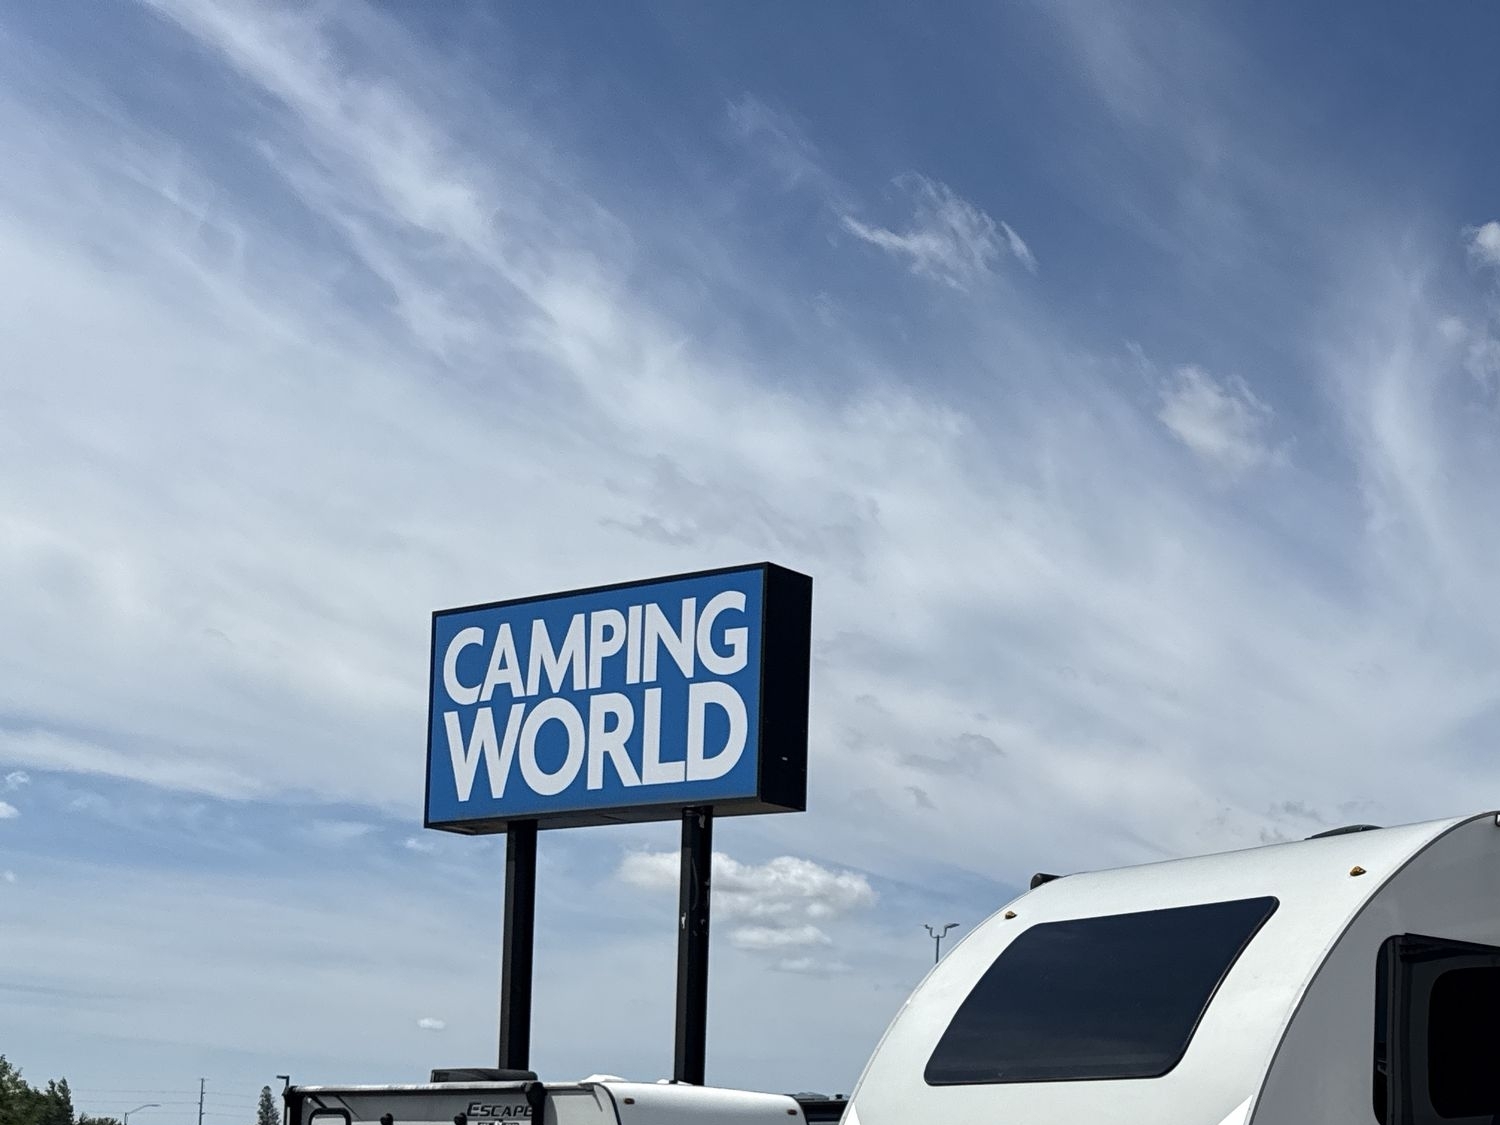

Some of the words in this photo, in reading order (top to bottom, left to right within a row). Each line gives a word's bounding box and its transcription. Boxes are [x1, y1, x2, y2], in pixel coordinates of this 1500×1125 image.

[443, 590, 749, 706] CAMPING
[443, 681, 749, 802] WORLD
[467, 1102, 533, 1117] ESCAPE
